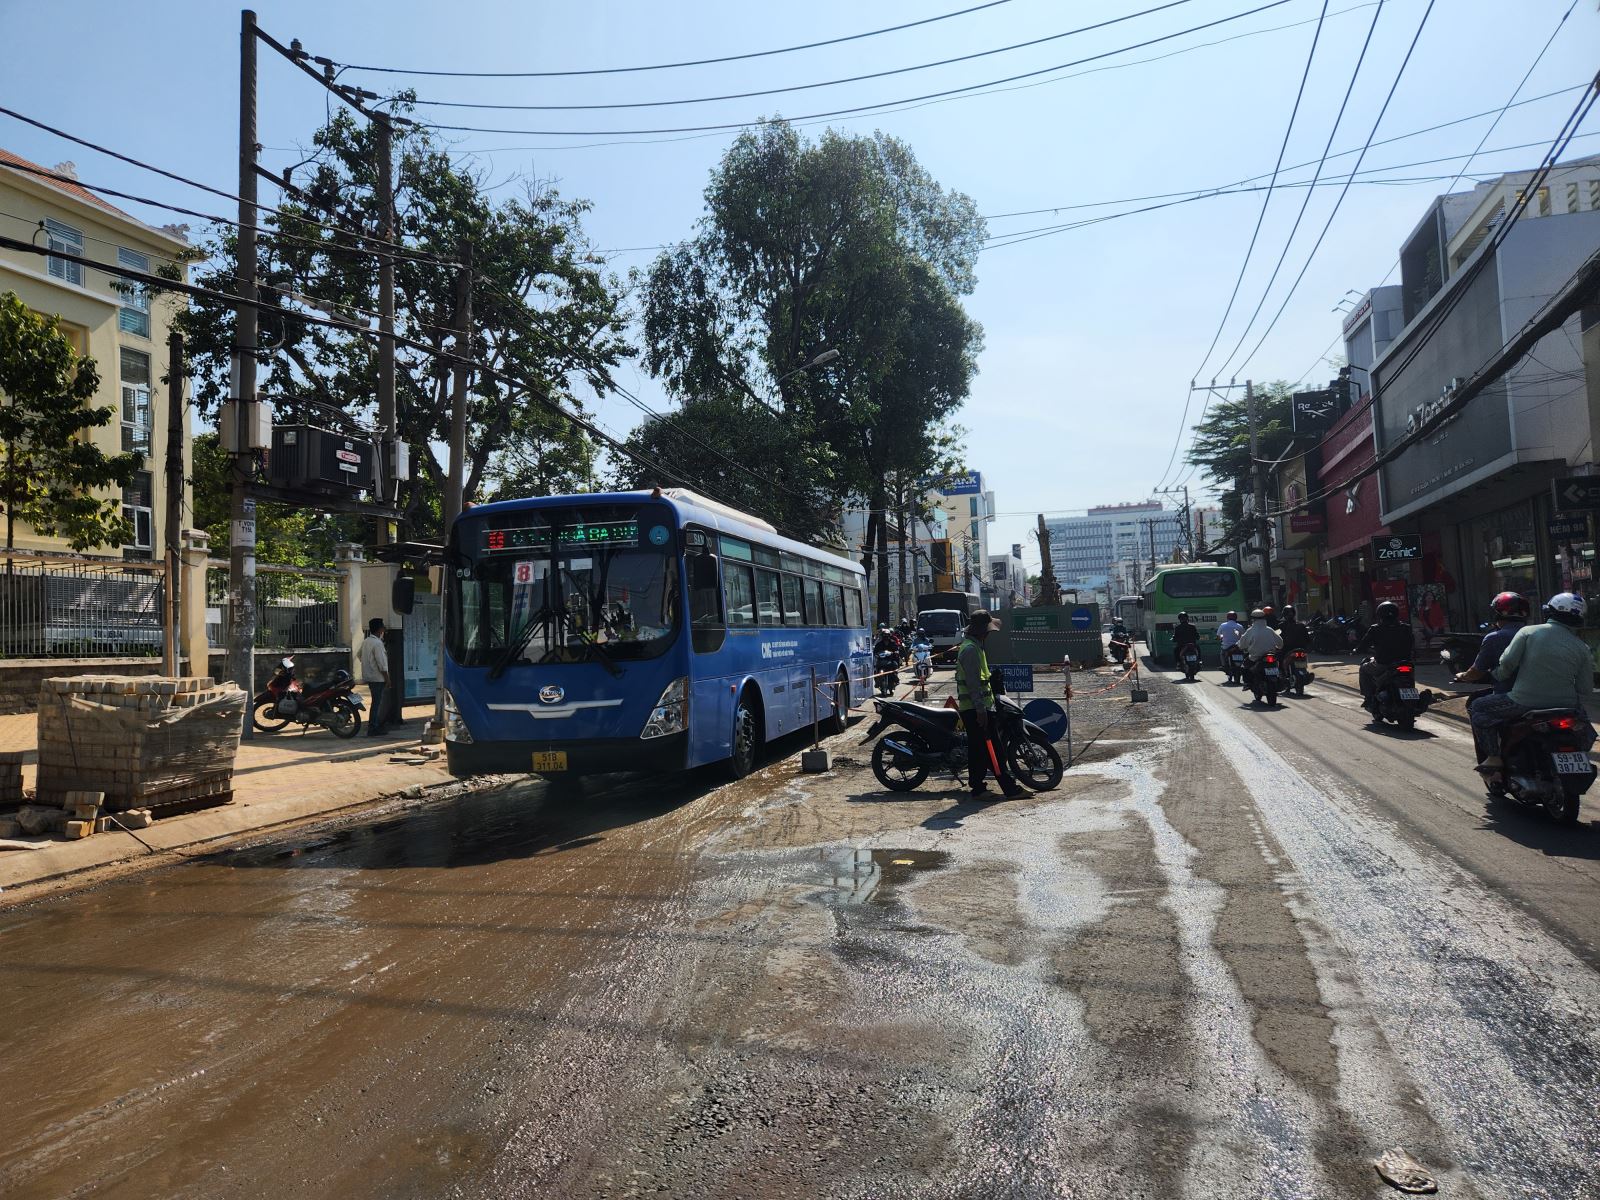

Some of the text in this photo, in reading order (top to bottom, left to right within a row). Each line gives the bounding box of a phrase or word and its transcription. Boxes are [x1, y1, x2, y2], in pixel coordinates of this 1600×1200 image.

[1379, 547, 1414, 558] Zennic
[518, 564, 531, 583] 8
[761, 642, 772, 659] CNG
[542, 752, 557, 761] 51B
[1558, 762, 1590, 772] 387.42
